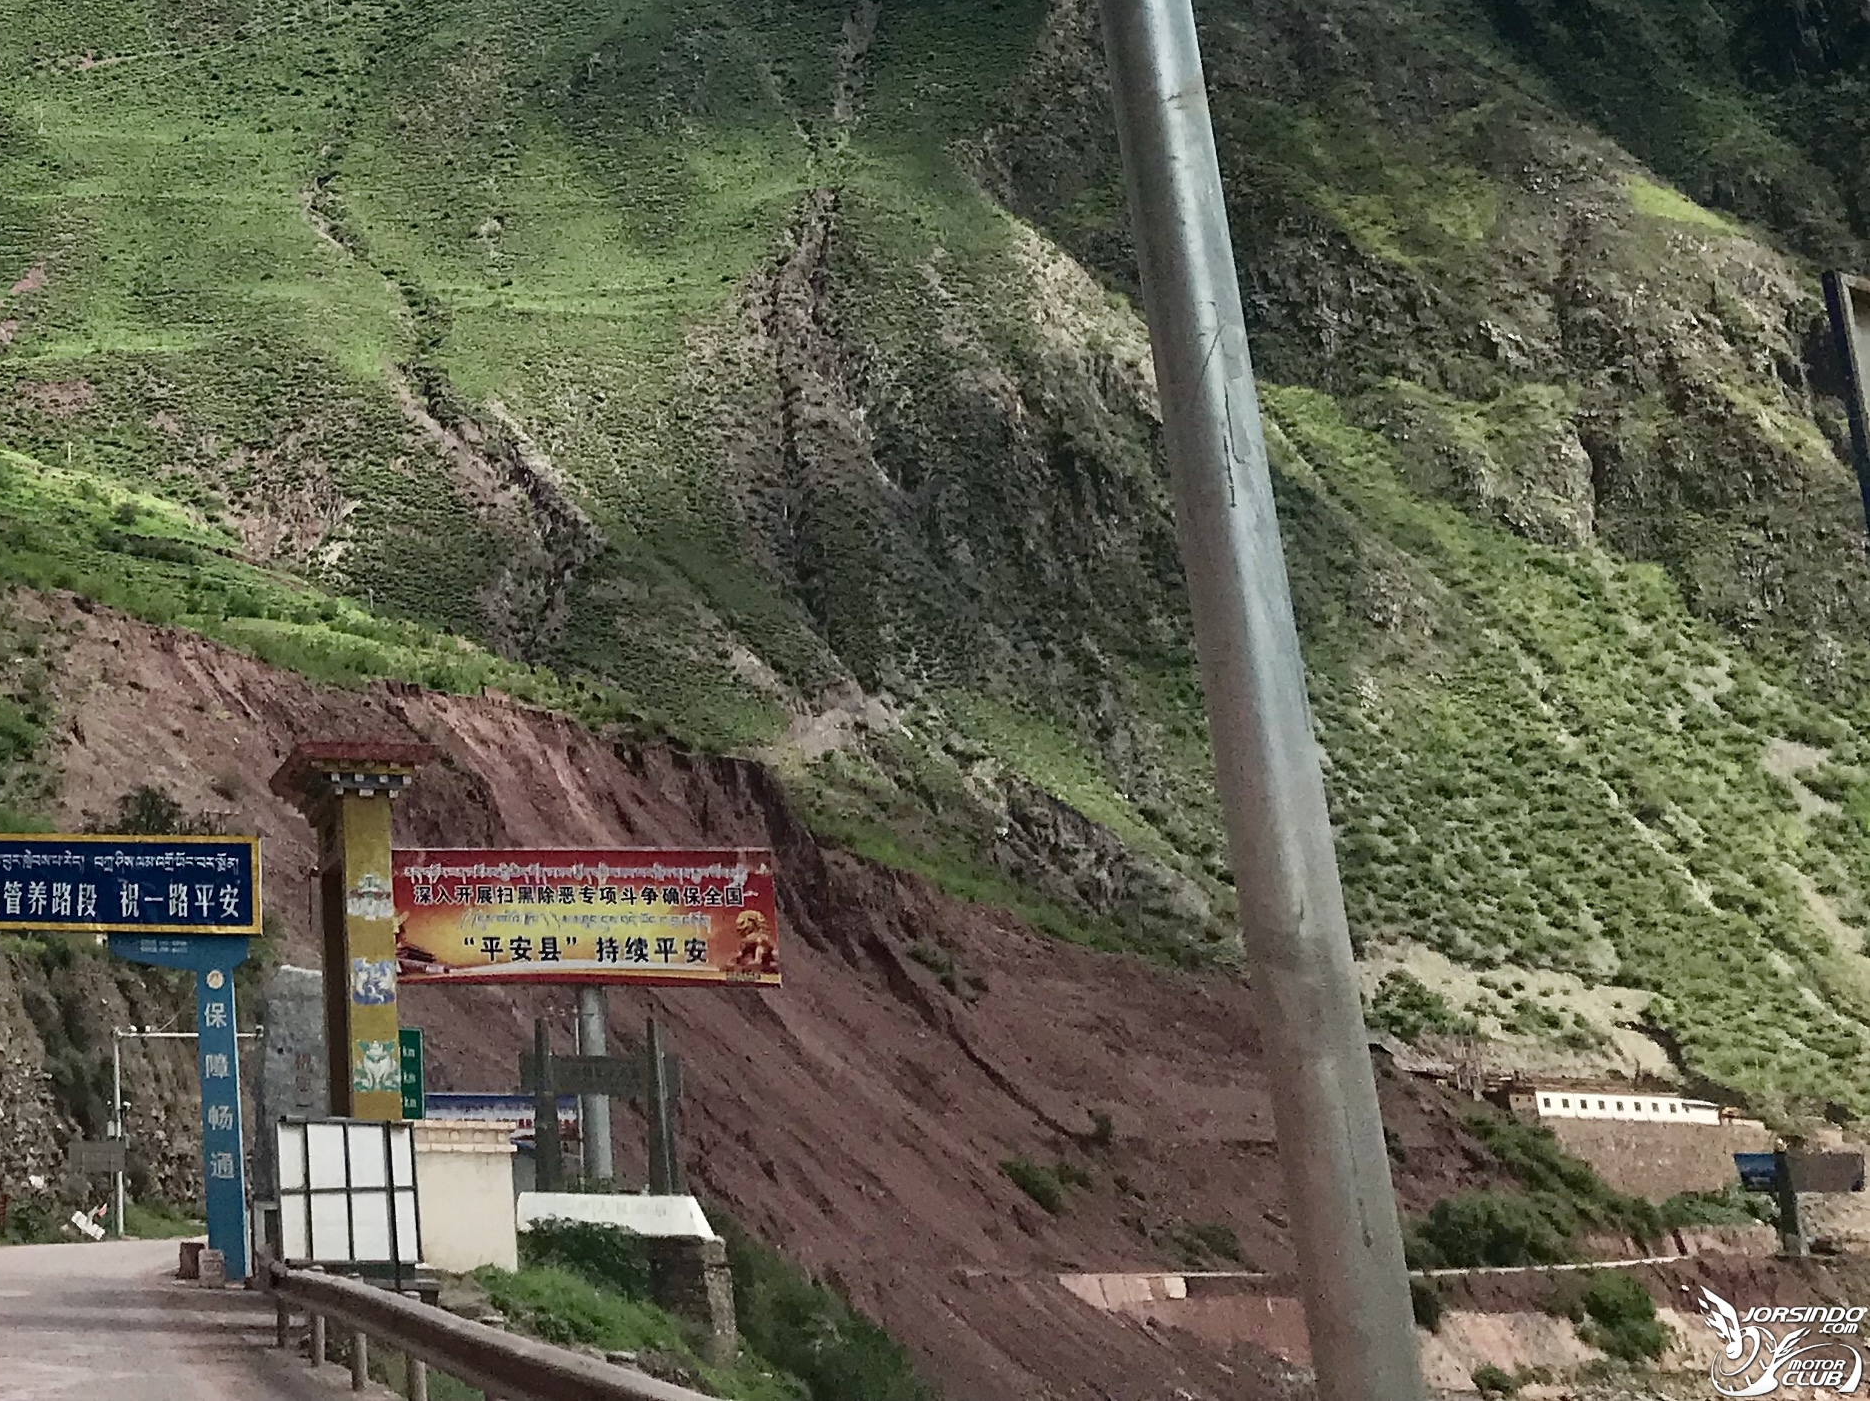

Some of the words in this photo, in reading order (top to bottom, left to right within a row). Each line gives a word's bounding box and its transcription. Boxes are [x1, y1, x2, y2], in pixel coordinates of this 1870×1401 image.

[119, 882, 240, 918] 祝一路平安
[414, 885, 744, 907] 深入开展扫黑除恶专项斗争确保全国
[596, 936, 709, 963] 持续平安
[204, 1002, 235, 1180] 保障畅通
